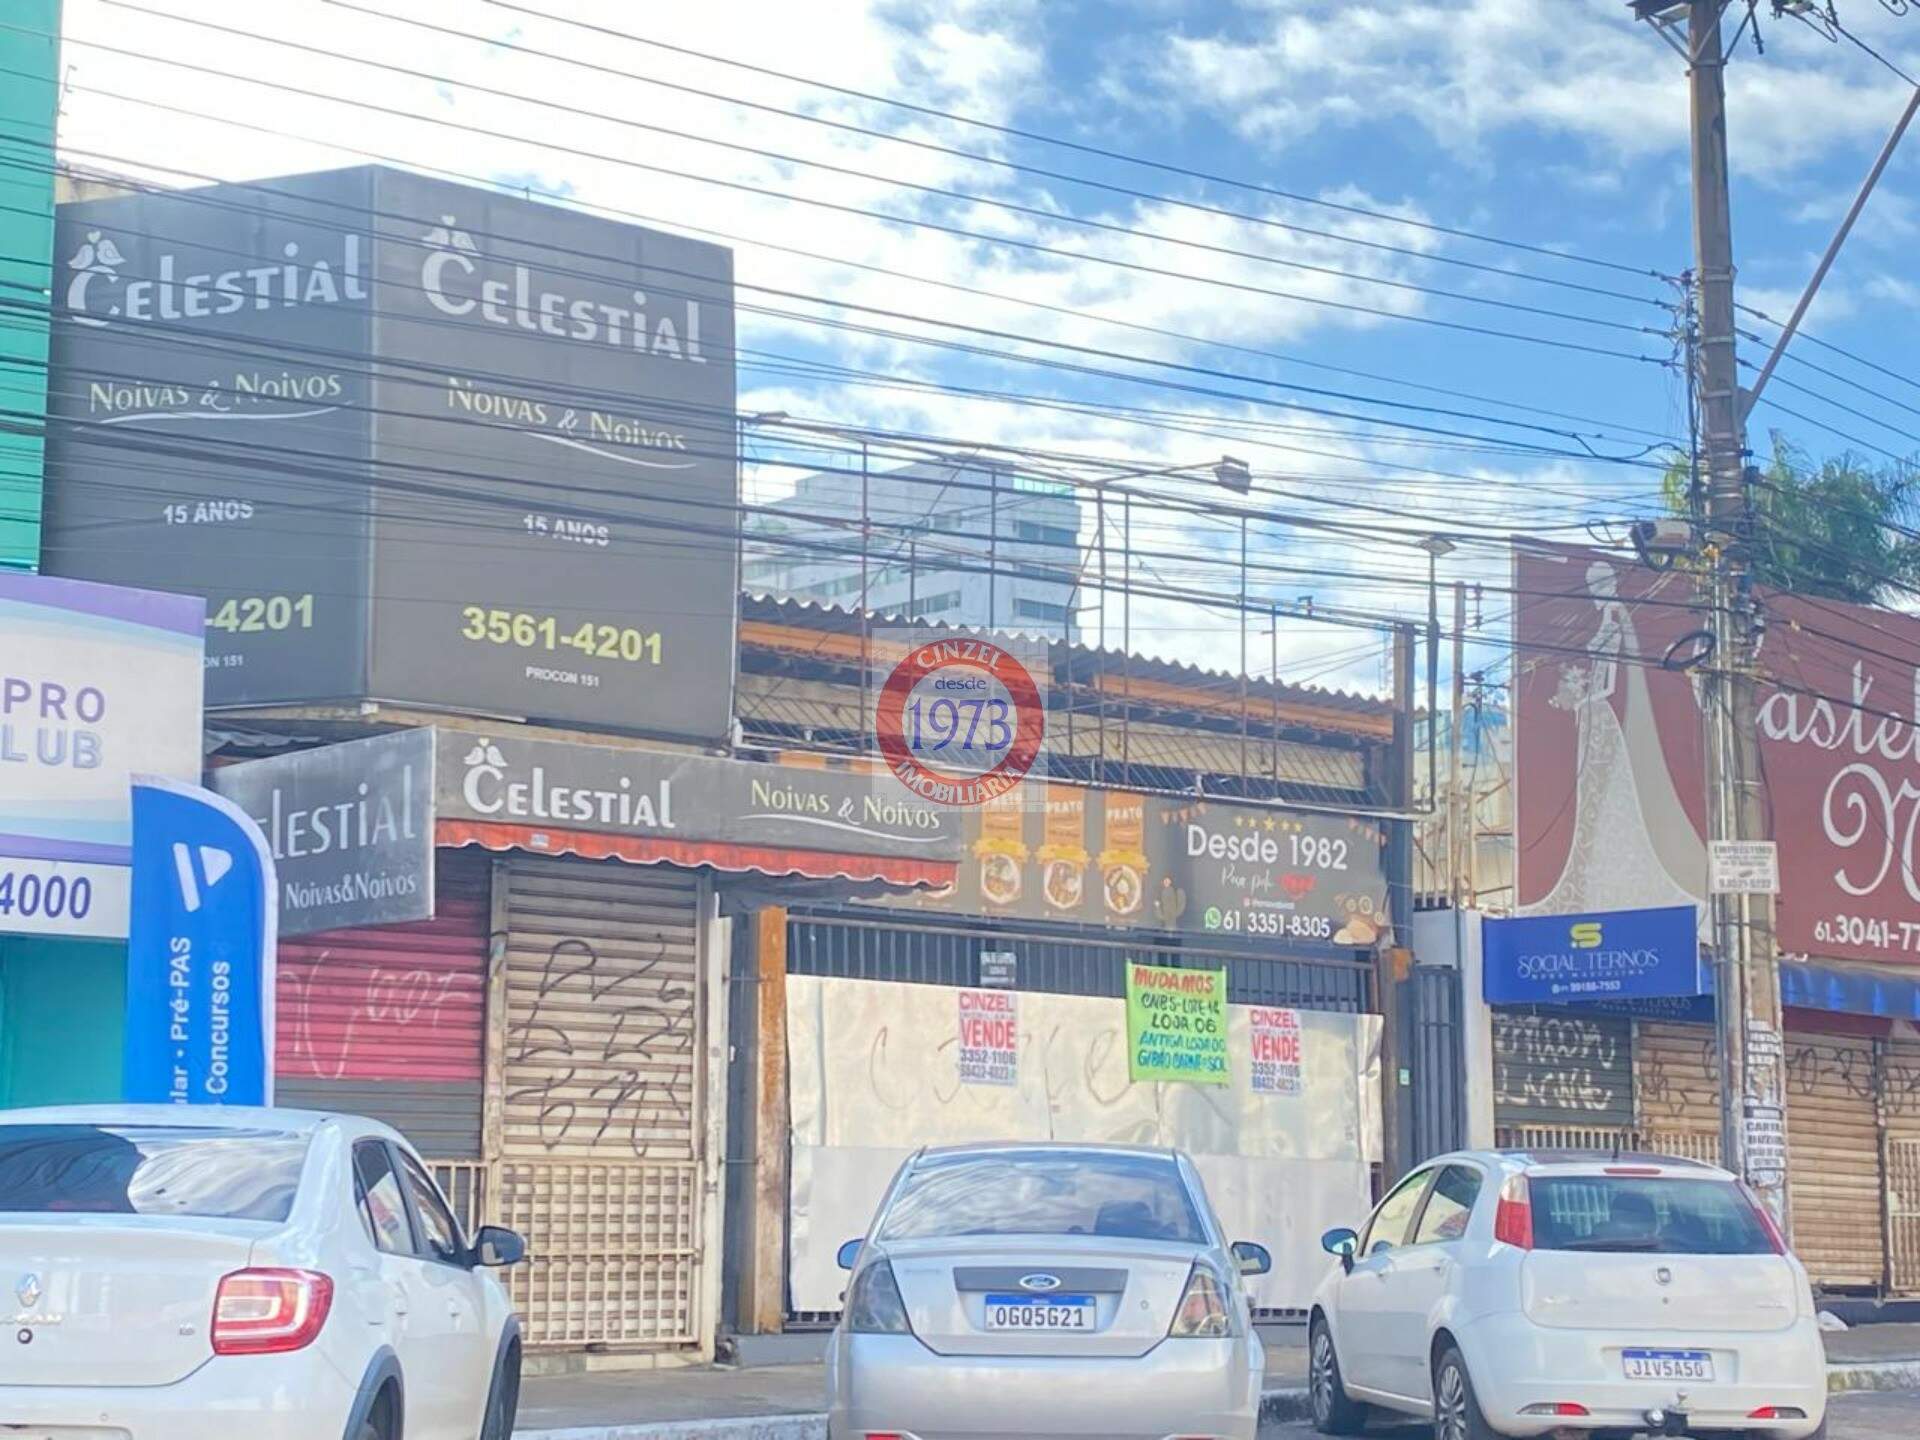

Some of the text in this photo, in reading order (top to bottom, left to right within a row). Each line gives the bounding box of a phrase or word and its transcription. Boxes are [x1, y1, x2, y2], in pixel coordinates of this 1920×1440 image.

[163, 500, 253, 526] 15 ANOS
[462, 606, 662, 665] 3561-4201
[525, 665, 577, 685] PROCON
[3, 678, 105, 723] PRO
[256, 764, 417, 860] LESTIAL
[1187, 824, 1348, 870] Desde 1982
[1223, 910, 1331, 938] 61 3351-8305
[1135, 967, 1215, 995] MUDAMOS
[959, 992, 1014, 1012] CINZEL
[205, 961, 231, 1094] Concursos
[1195, 1018, 1217, 1033] 06
[1250, 1009, 1299, 1029] CINZEL
[960, 1018, 1015, 1049] VENDE
[1251, 1034, 1300, 1064] VENDE
[996, 1306, 1085, 1328] OGQ5G21
